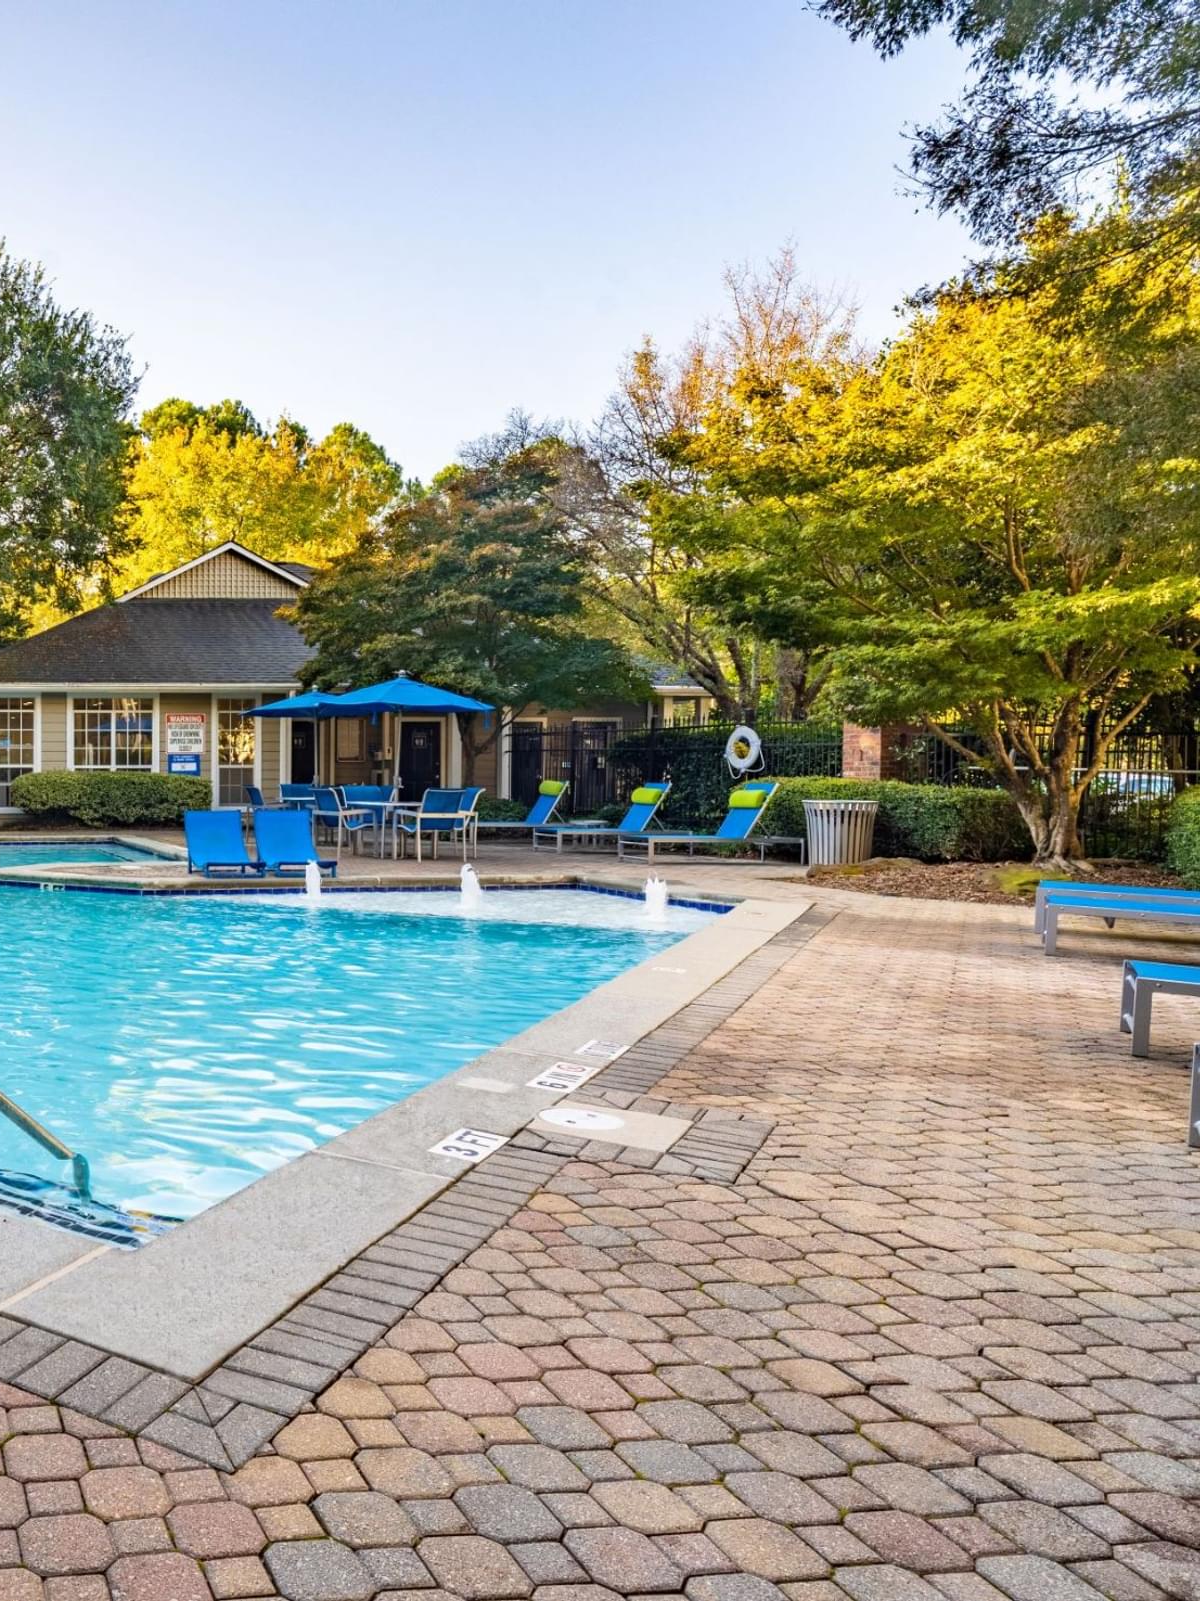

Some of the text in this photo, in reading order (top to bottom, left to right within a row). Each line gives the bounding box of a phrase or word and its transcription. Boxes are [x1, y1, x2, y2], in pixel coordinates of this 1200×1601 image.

[169, 715, 202, 723] WARNING
[536, 1071, 583, 1090] 6 IN
[442, 1131, 498, 1157] 3 FT
